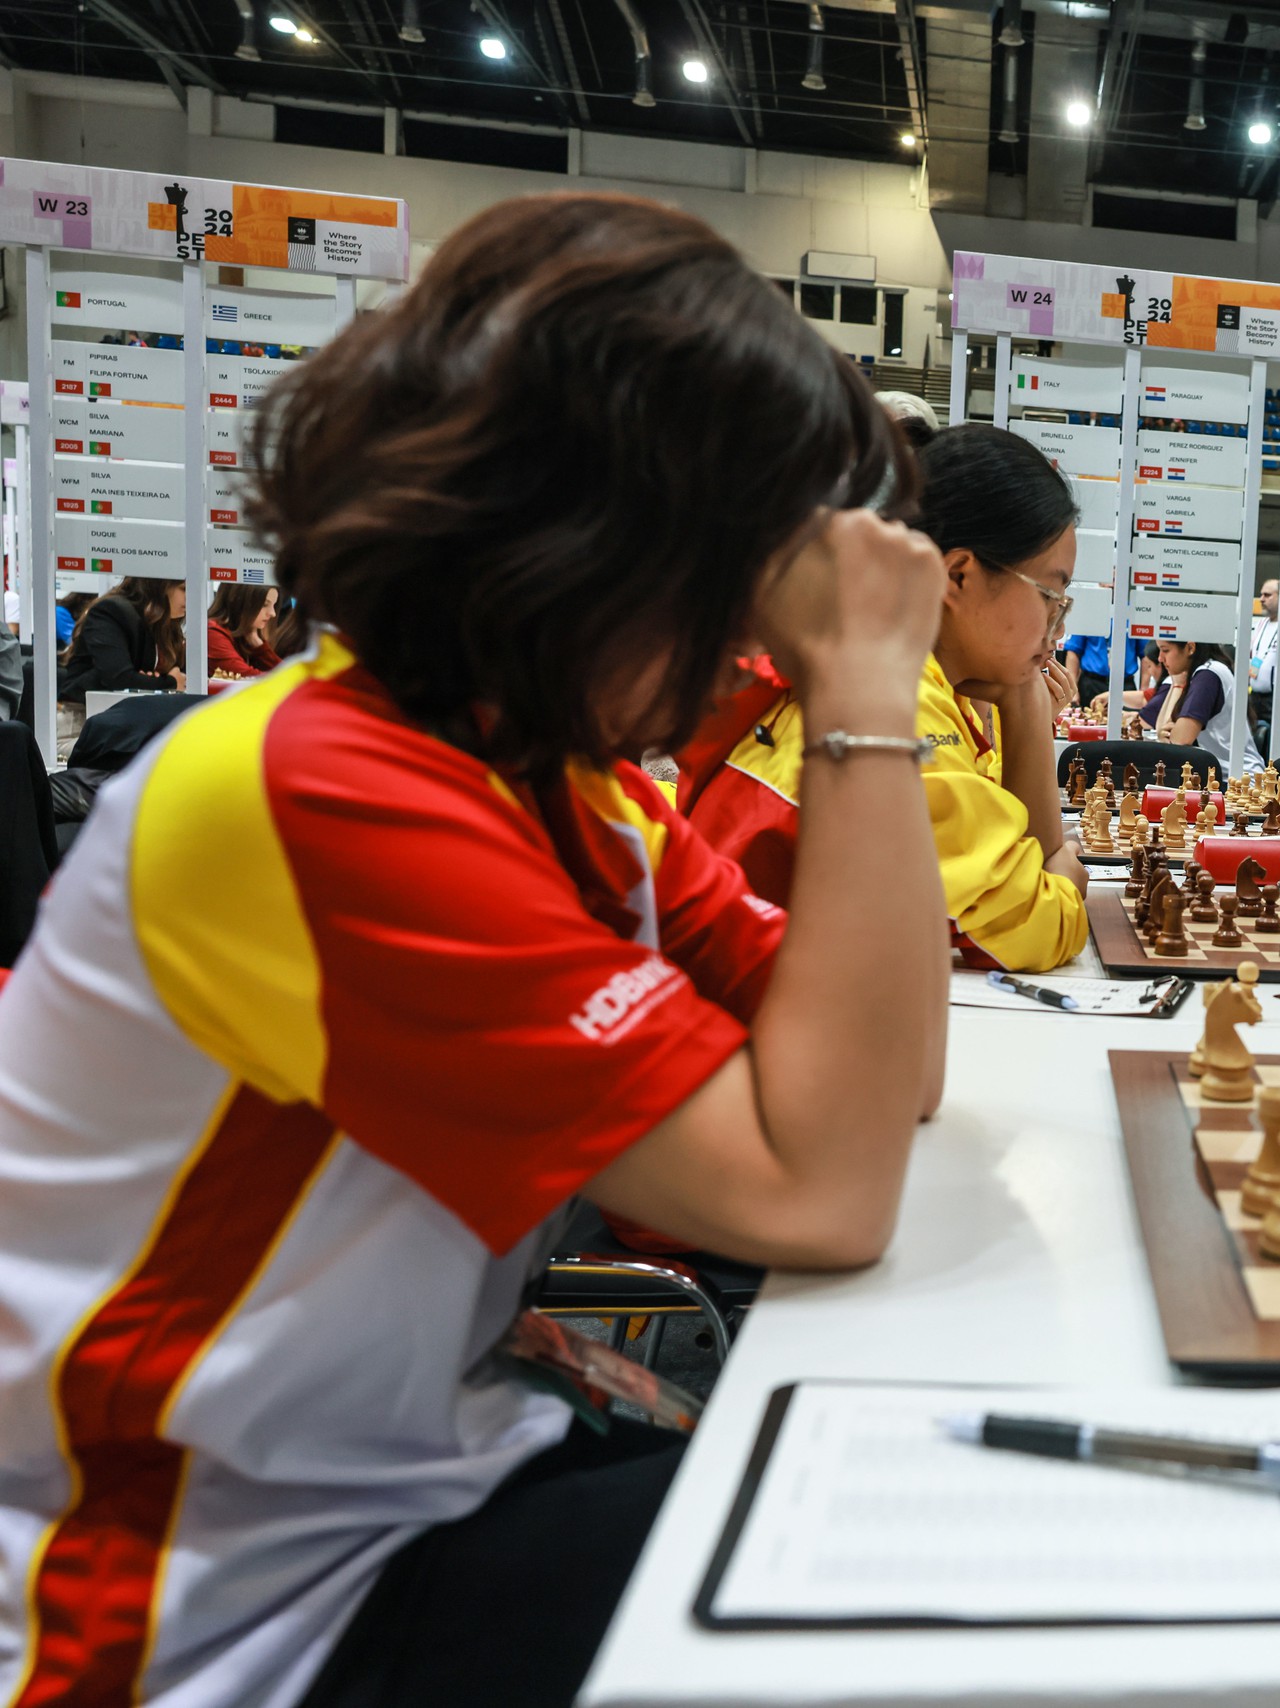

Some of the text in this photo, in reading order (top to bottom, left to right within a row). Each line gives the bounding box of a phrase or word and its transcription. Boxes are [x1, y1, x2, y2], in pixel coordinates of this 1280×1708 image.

[38, 198, 88, 216] W 23
[204, 208, 233, 223] 20
[204, 222, 233, 237] 24
[176, 232, 205, 246] PE
[329, 232, 357, 241] Where
[340, 240, 362, 249] Story
[177, 245, 205, 260] ST
[324, 246, 362, 256] Becomes
[328, 254, 358, 264] History
[1011, 290, 1053, 306] W 24
[88, 298, 127, 308] PORTUGAL
[1148, 297, 1172, 310] 20
[244, 312, 273, 321] GREECE
[1147, 310, 1172, 324] 24
[1124, 319, 1148, 332] PE
[1250, 317, 1275, 326] Where
[1259, 325, 1278, 333] Story
[1123, 332, 1148, 345] ST
[1246, 330, 1278, 339] Becomes
[1249, 338, 1275, 347] History
[89, 353, 118, 361] PIPIRAS
[89, 369, 148, 380] FILIPA FORTUNA
[243, 367, 288, 377] TSOLAKIDO
[1170, 392, 1204, 400] PARAGUAY
[89, 412, 110, 420] SILVA
[58, 418, 79, 426] WCM
[89, 429, 125, 437] MARIANA
[1041, 432, 1074, 440] BRUNELLO
[1040, 446, 1066, 454] MARINA
[1189, 443, 1224, 452] RODRIGUEZ
[127, 490, 159, 498] TEIXEIRA
[1165, 509, 1196, 517] GABRIELA
[91, 530, 116, 538] DUQUE
[138, 549, 168, 557] SANTOS
[1163, 548, 1190, 556] MONTIEL
[243, 557, 276, 565] HARITOM
[926, 731, 962, 748] Bank
